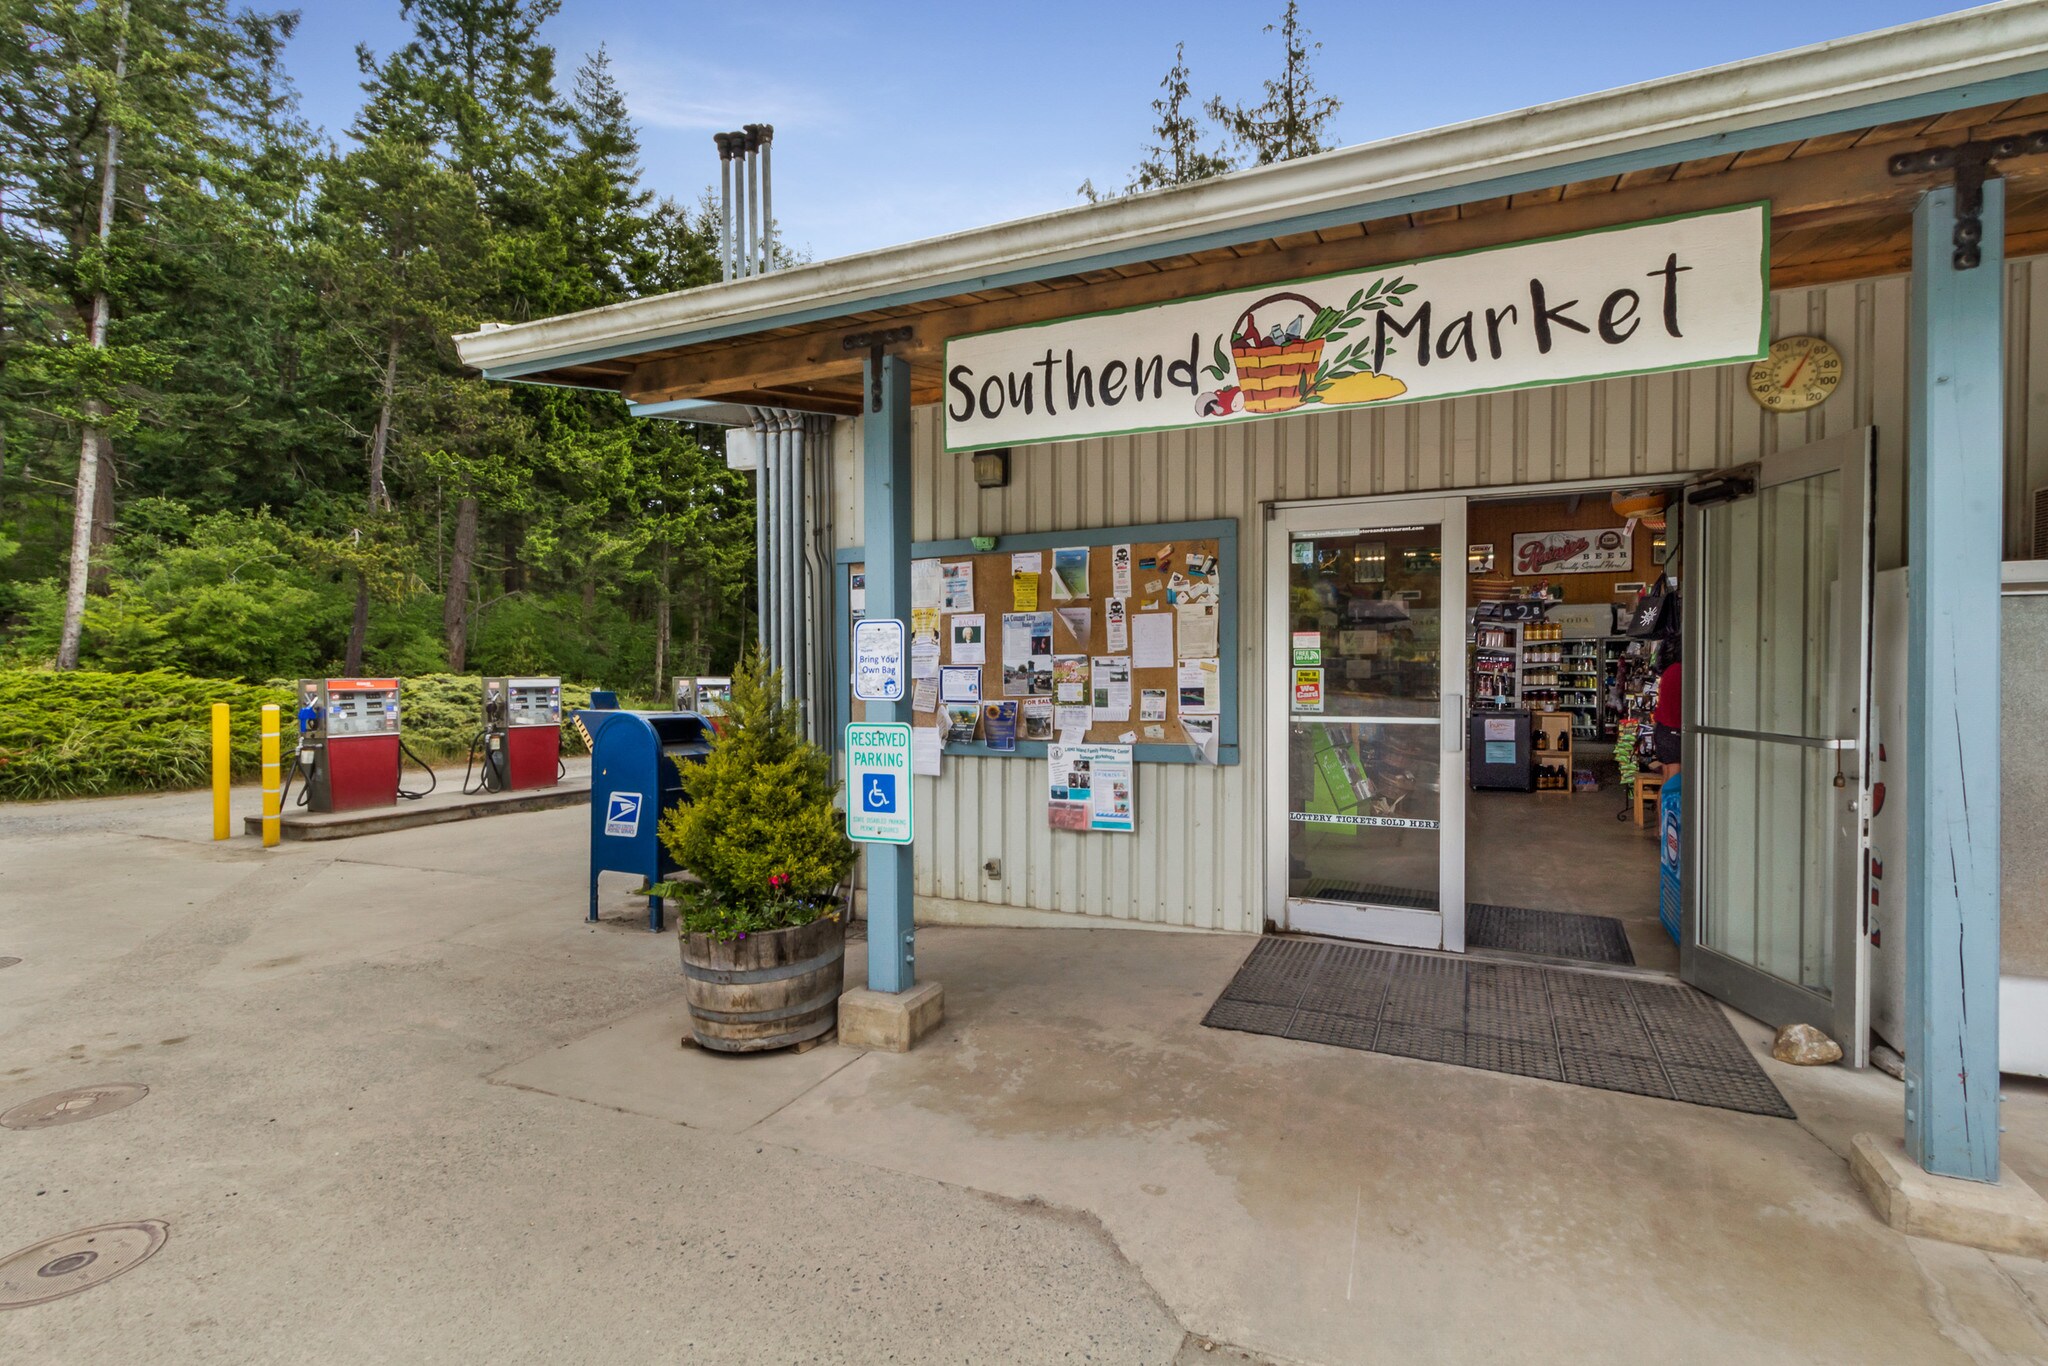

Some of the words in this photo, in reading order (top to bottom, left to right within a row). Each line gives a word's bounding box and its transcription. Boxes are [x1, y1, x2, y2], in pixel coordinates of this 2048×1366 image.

[949, 332, 1200, 422] Southend
[1374, 252, 1693, 374] Market
[1776, 343, 1789, 352] 20
[1795, 339, 1809, 347] 40
[1813, 345, 1828, 354] 60
[1823, 359, 1838, 368] 80
[1820, 376, 1837, 385] 100
[1806, 392, 1822, 401] 120
[1583, 552, 1627, 560] BEER
[1517, 605, 1533, 620] 2
[958, 619, 978, 627] BACH
[860, 655, 879, 665] Bring
[881, 655, 899, 664] Your
[861, 666, 880, 674] Own
[882, 666, 896, 676] Bag
[851, 731, 906, 747] RESERVED
[854, 752, 903, 768] PARKING
[1289, 812, 1333, 822] LOTTERY
[1336, 815, 1377, 825] TICKETS
[1381, 818, 1406, 826] SOLD
[1409, 820, 1440, 829] HERE
